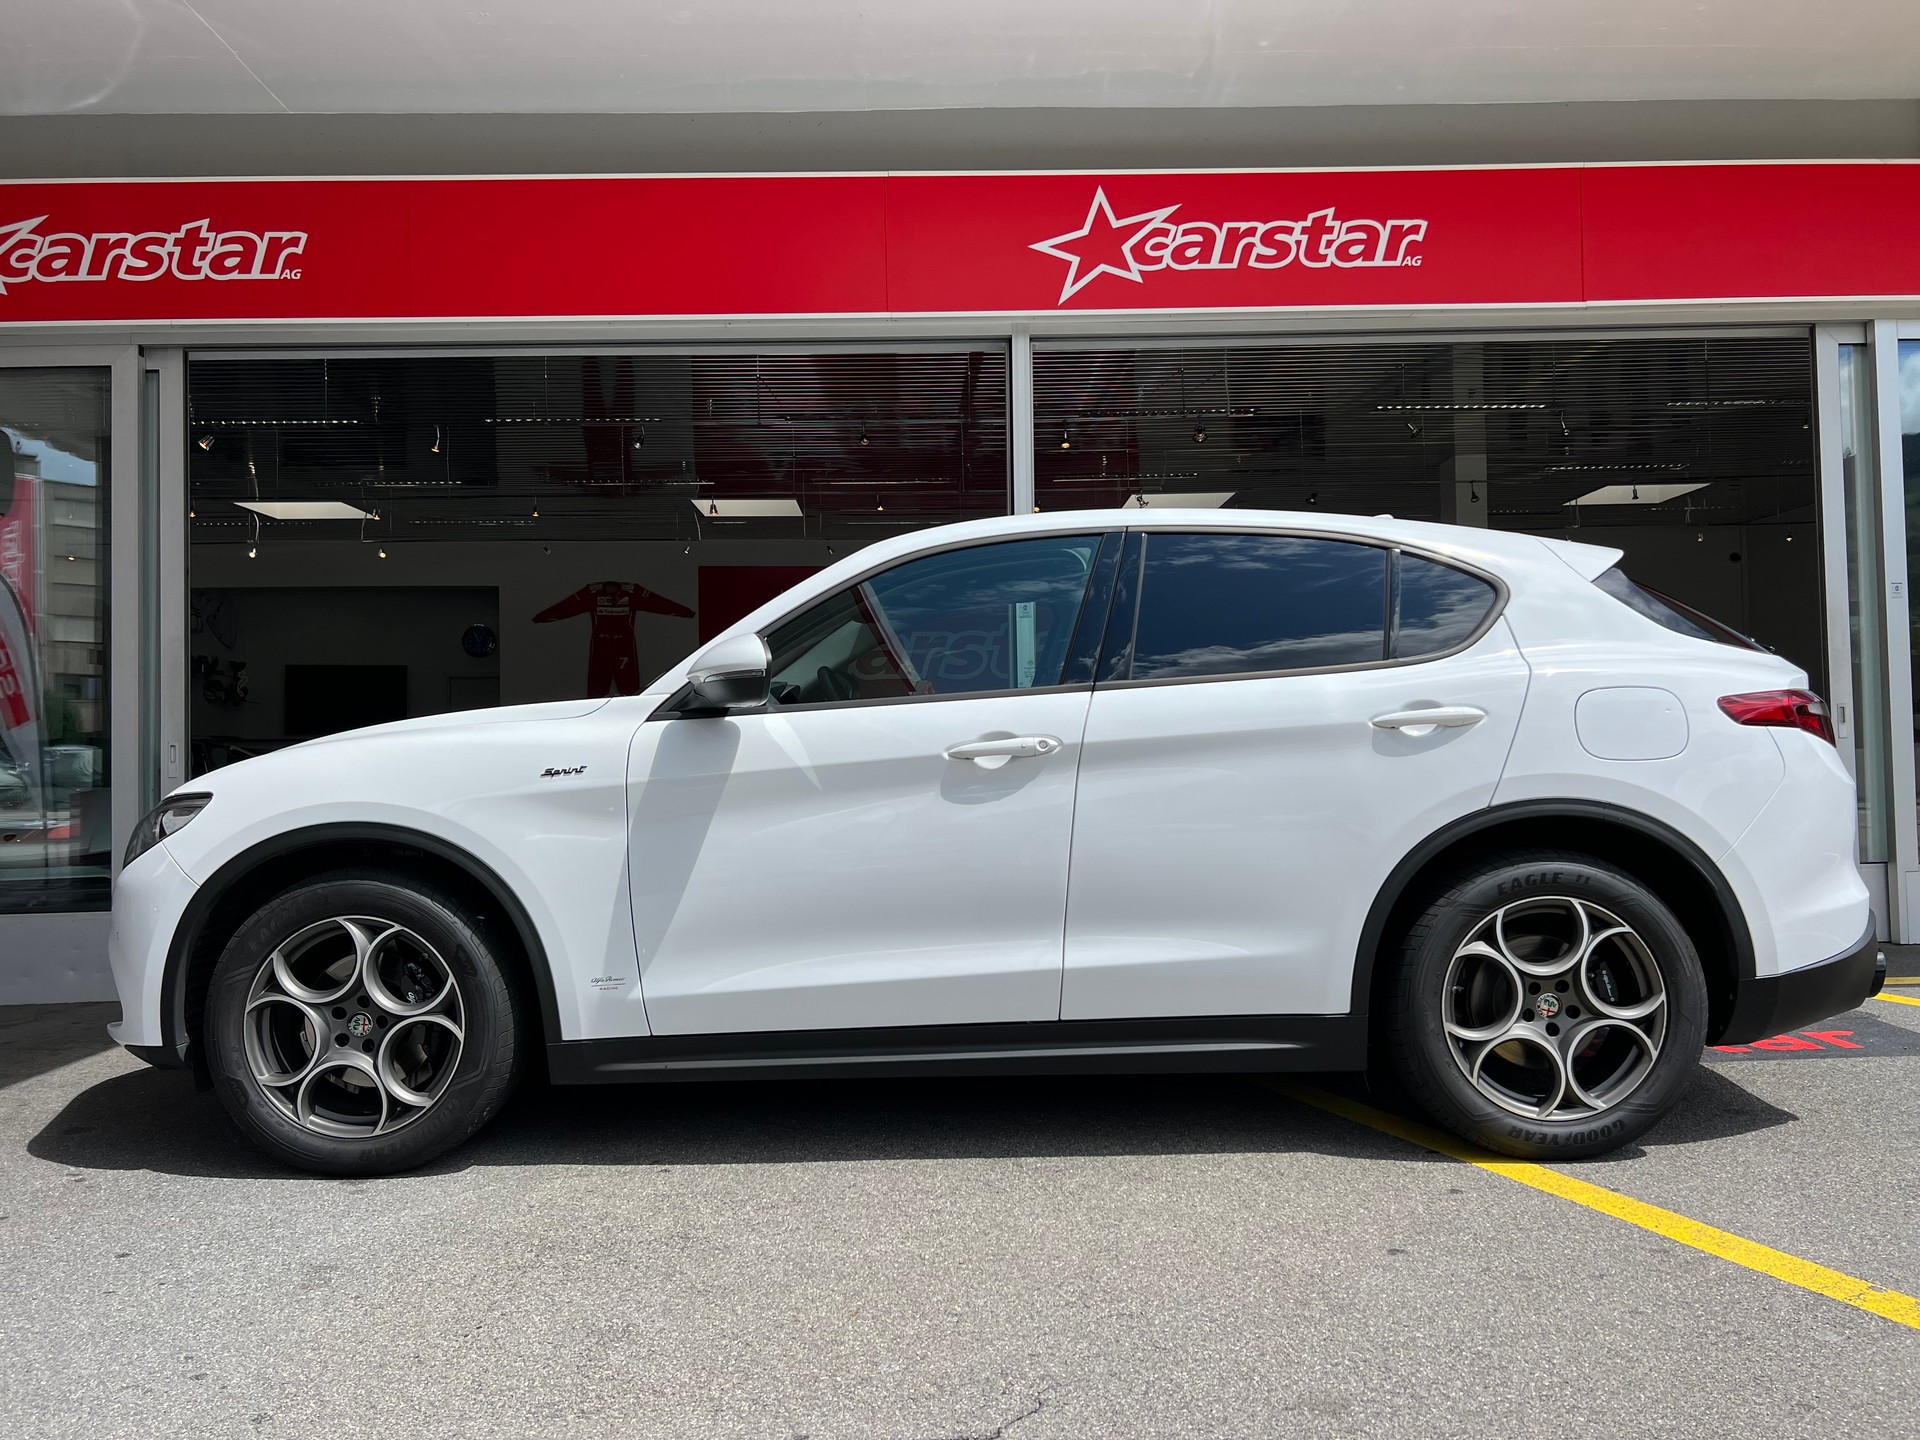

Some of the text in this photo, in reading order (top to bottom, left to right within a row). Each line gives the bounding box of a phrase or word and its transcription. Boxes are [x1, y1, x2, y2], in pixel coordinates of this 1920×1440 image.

[0, 218, 308, 283] carstar AG
[1132, 207, 1428, 271] carstar AG
[619, 657, 629, 670] 7
[540, 766, 588, 779] Sprint
[1497, 872, 1564, 895] EAGLE
